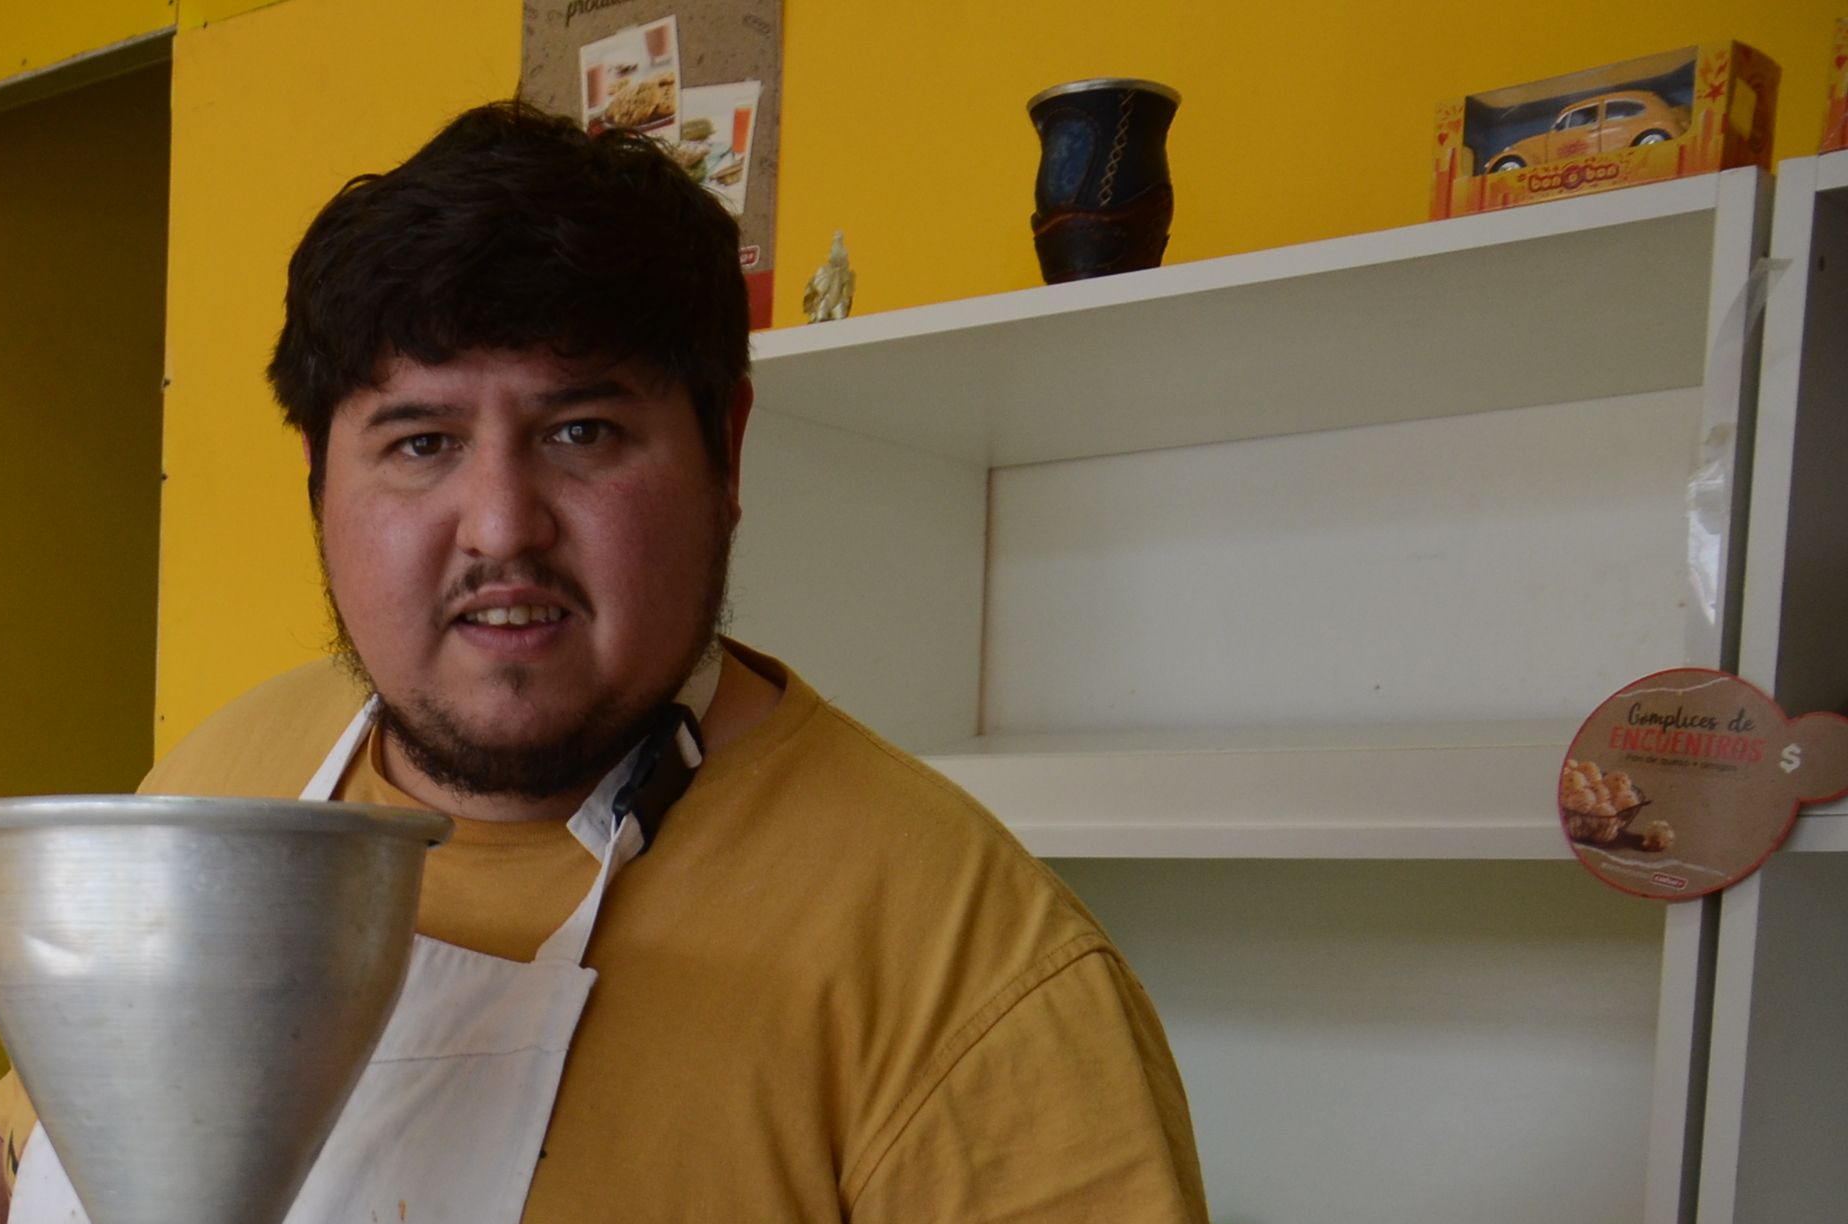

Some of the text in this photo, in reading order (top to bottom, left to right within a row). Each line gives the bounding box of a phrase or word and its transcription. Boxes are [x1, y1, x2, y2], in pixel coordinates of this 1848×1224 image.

[1727, 707, 1756, 732] de
[1608, 725, 1770, 763] ENCUENTROS
[1779, 743, 1802, 774] $
